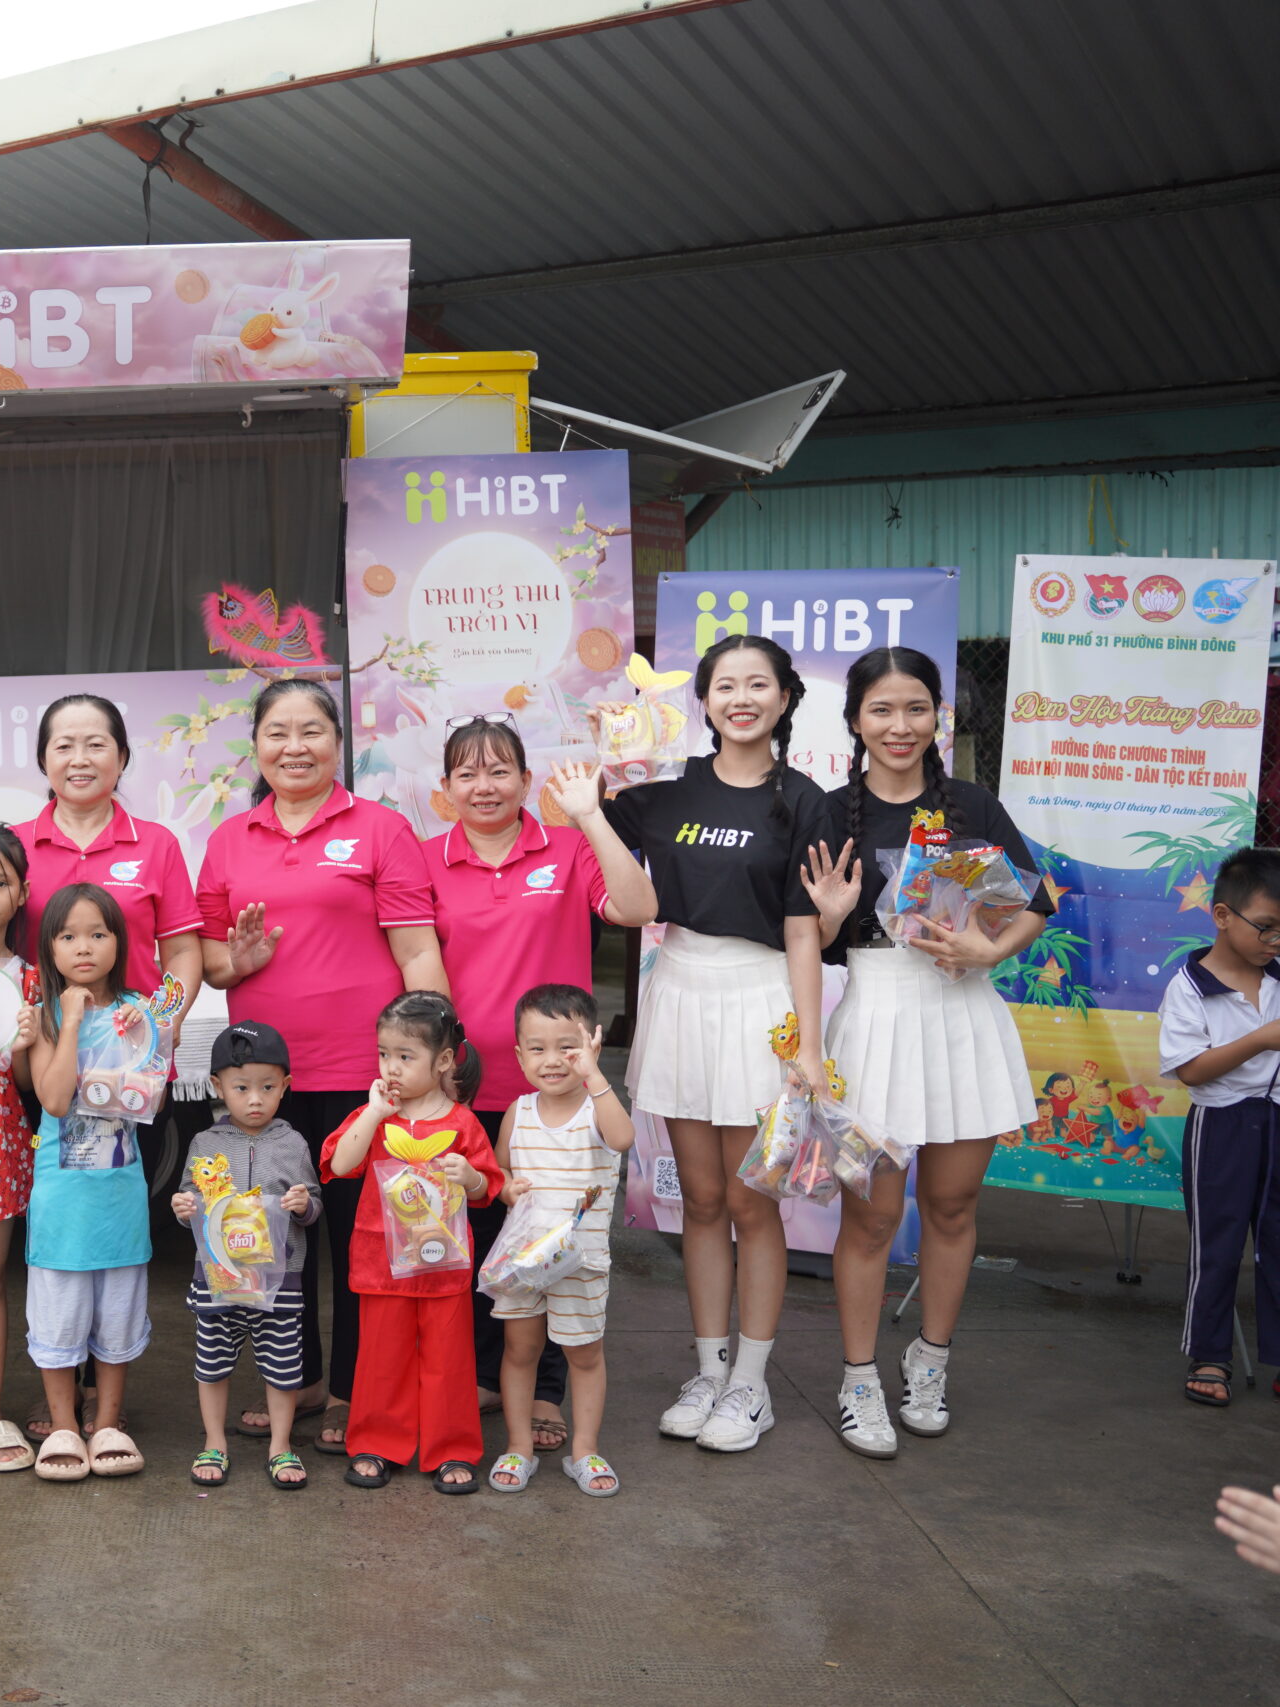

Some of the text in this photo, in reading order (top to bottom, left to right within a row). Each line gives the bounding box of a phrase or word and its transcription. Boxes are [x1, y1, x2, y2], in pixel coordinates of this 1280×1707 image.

[456, 474, 567, 517] HiBT
[761, 598, 914, 652] HiBT
[1041, 632, 1065, 645] KHU
[1068, 630, 1093, 647] PHỐ
[1095, 635, 1109, 647] 31
[1064, 761, 1089, 778] NON
[1091, 762, 1124, 781] SÔNG
[1135, 765, 1159, 783] DÂN
[699, 826, 754, 848] HiBT
